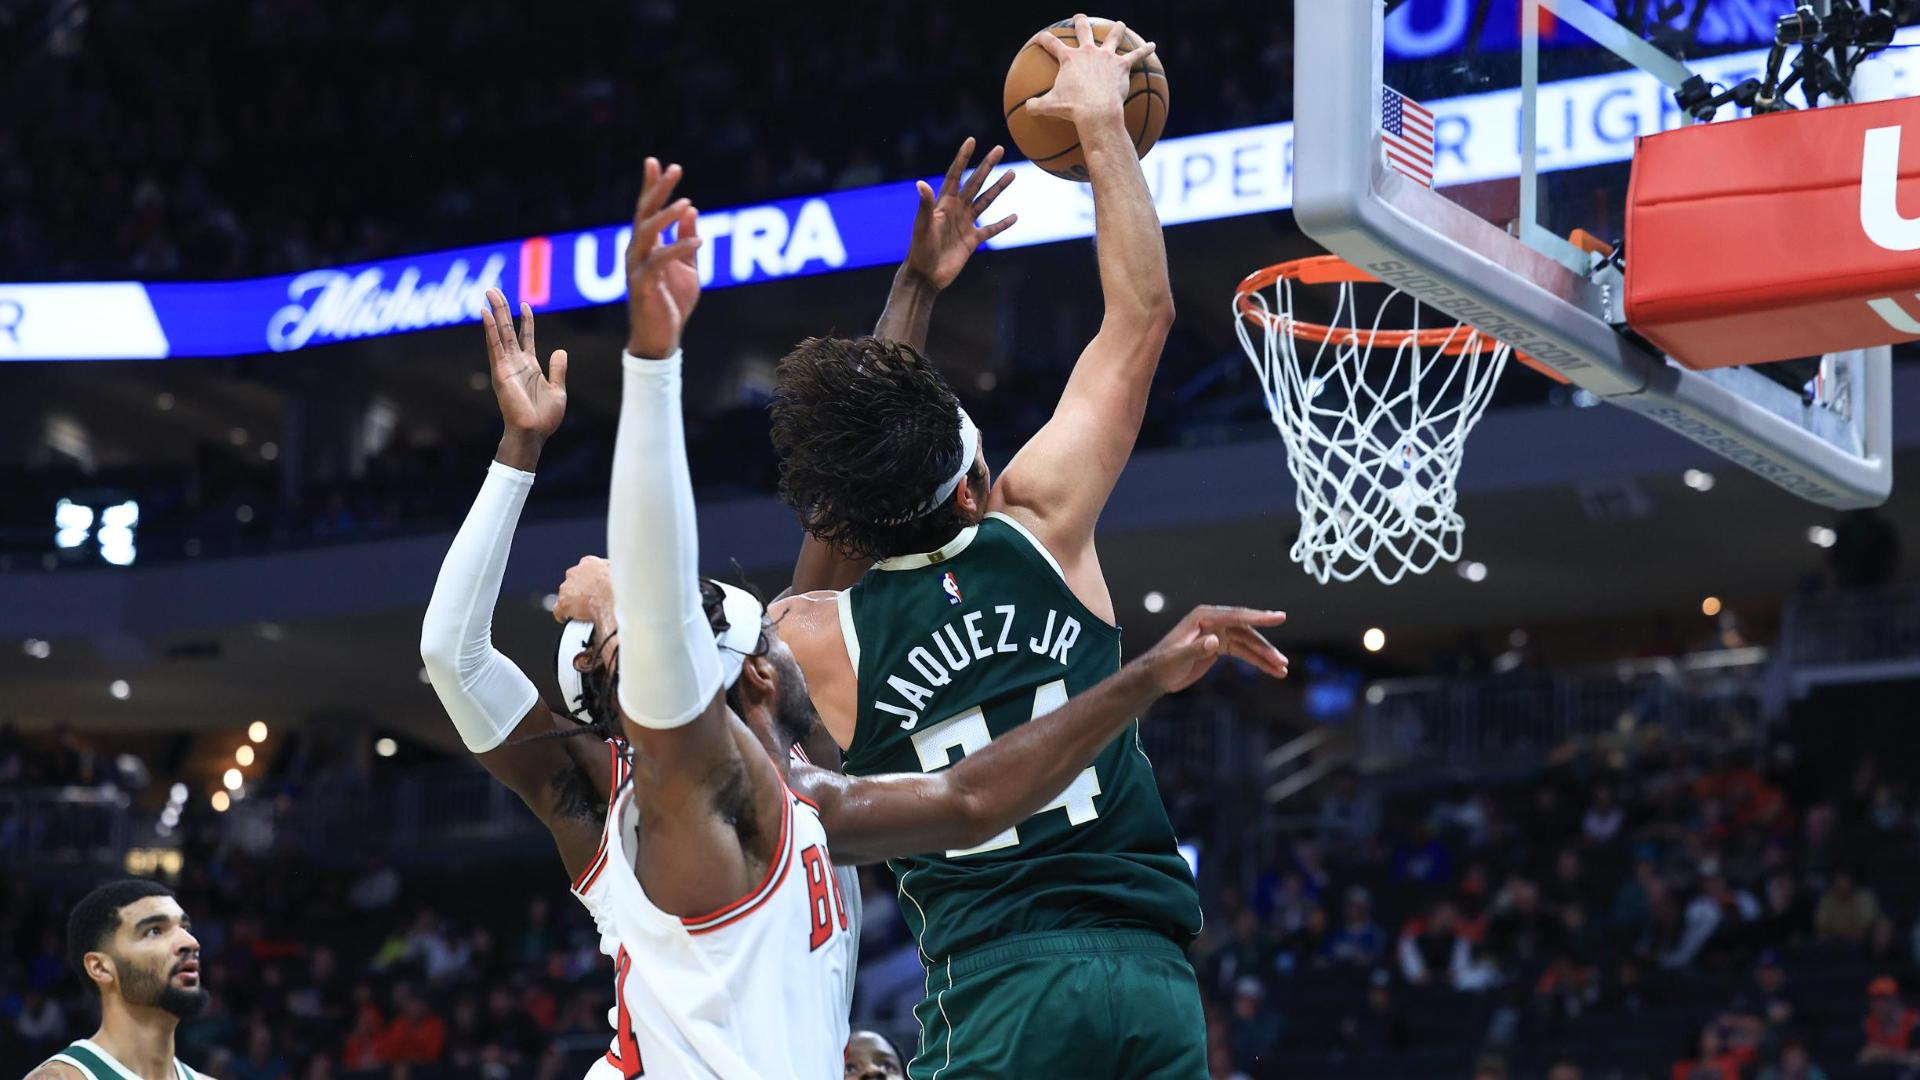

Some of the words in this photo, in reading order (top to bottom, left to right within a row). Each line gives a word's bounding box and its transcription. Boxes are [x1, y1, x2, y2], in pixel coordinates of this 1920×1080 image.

[574, 199, 847, 302] UTRA
[874, 604, 1018, 731] JAQUEZ
[1029, 609, 1082, 666] JR
